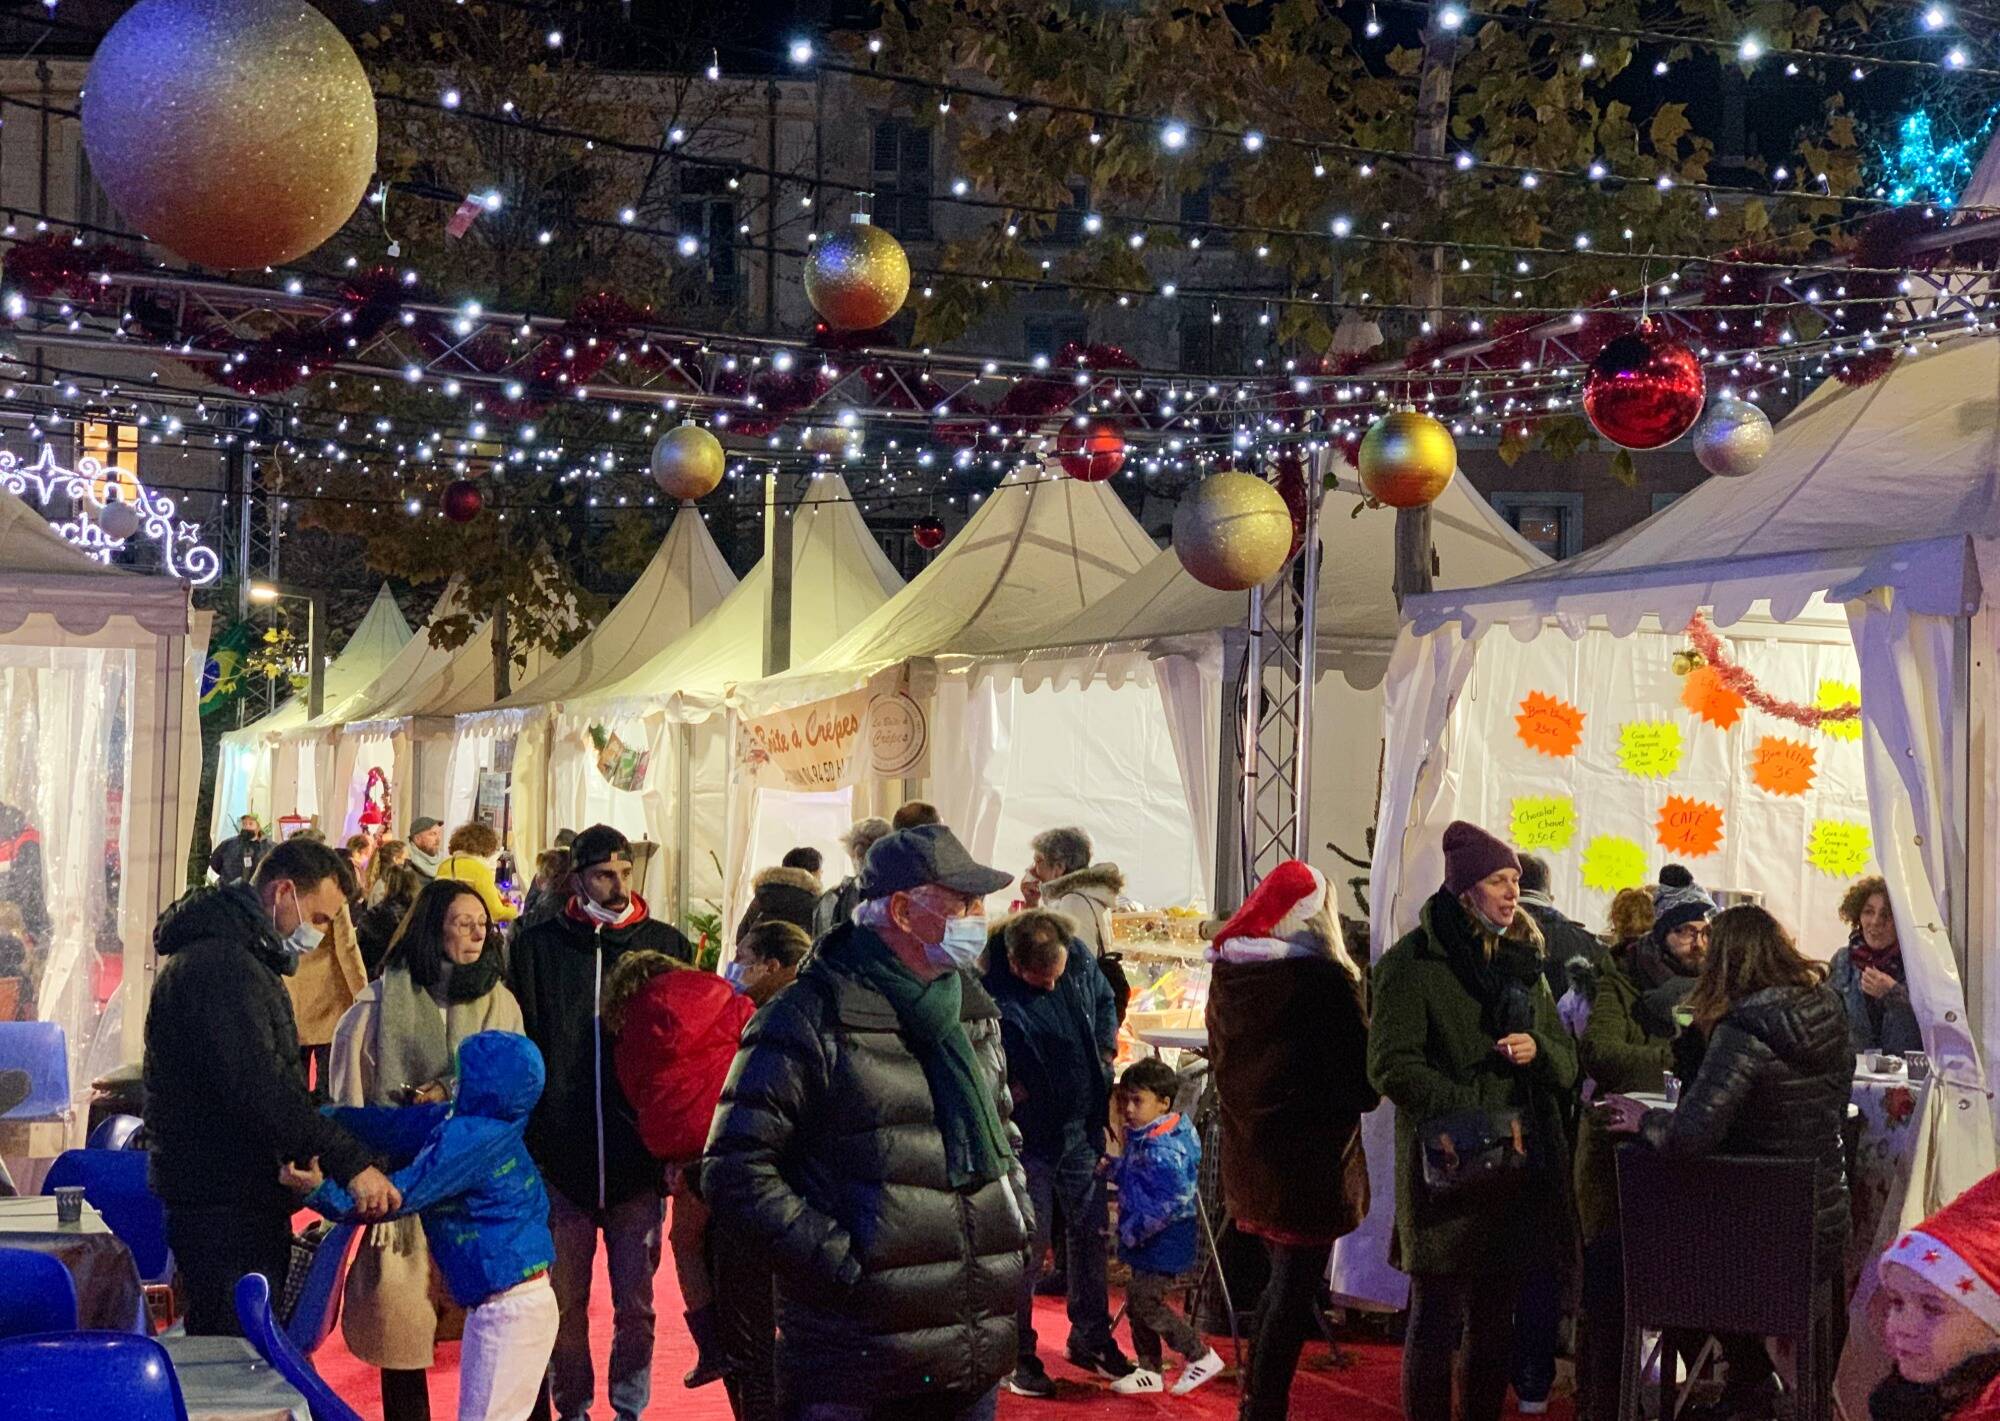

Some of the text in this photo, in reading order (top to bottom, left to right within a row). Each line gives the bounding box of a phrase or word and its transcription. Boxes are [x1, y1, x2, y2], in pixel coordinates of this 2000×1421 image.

[805, 709, 858, 750] Crêpes
[1773, 765, 1794, 779] 3€
[1519, 804, 1557, 824] Chocolat
[1537, 816, 1566, 829] Chaud
